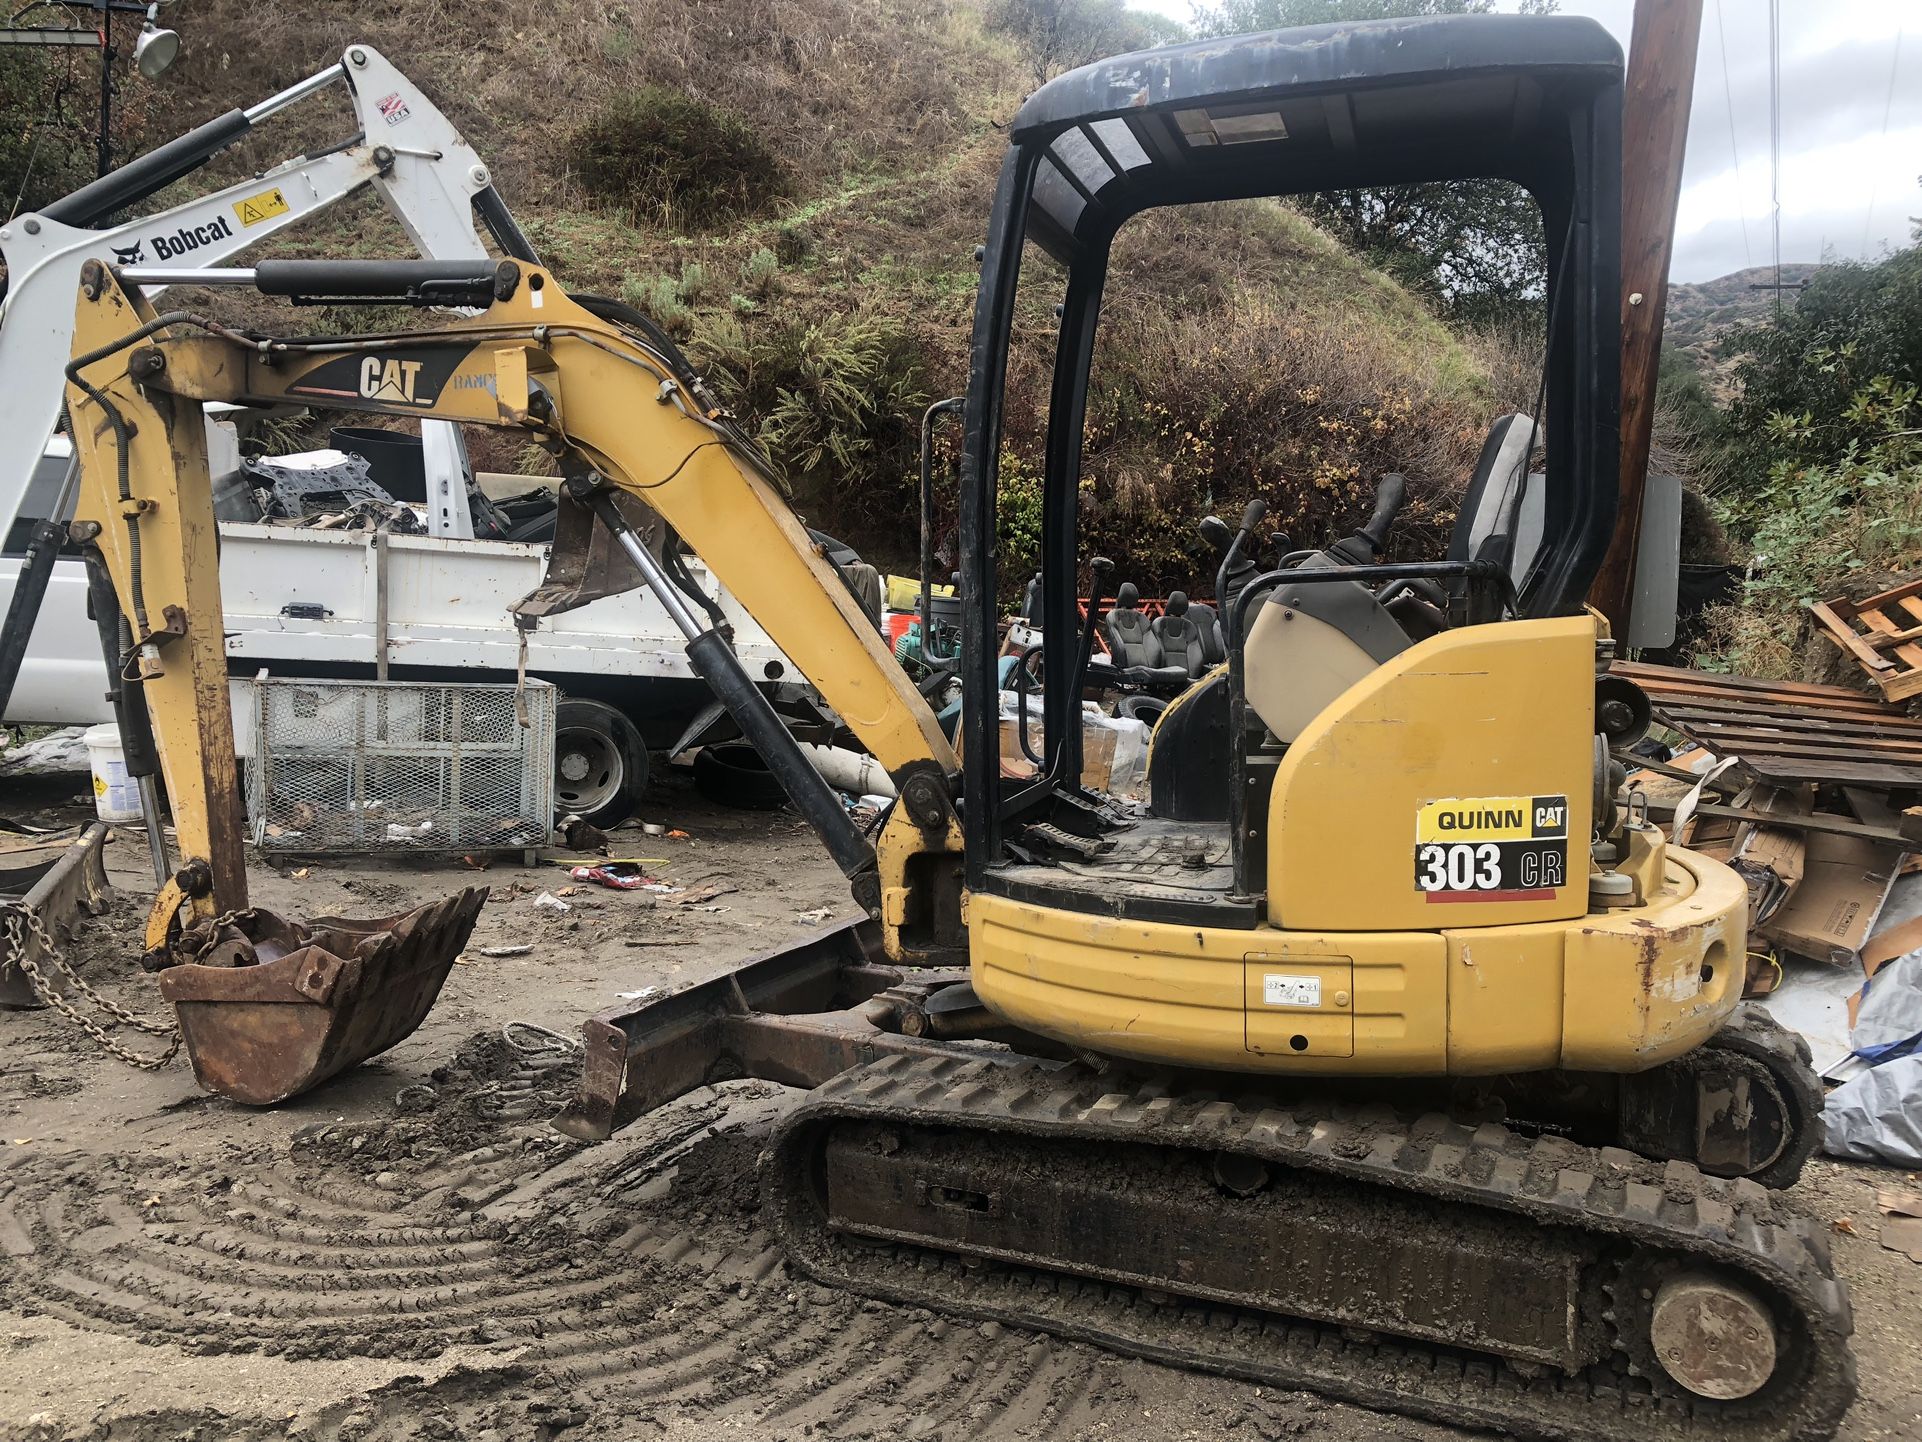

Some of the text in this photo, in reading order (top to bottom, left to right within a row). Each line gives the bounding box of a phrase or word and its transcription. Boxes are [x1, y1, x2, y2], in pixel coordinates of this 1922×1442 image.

[386, 107, 410, 124] USA
[150, 215, 233, 261] Bobcat
[360, 356, 422, 403] CAT
[1438, 806, 1564, 830] QUINN CAT
[1419, 843, 1562, 891] 303 CR
